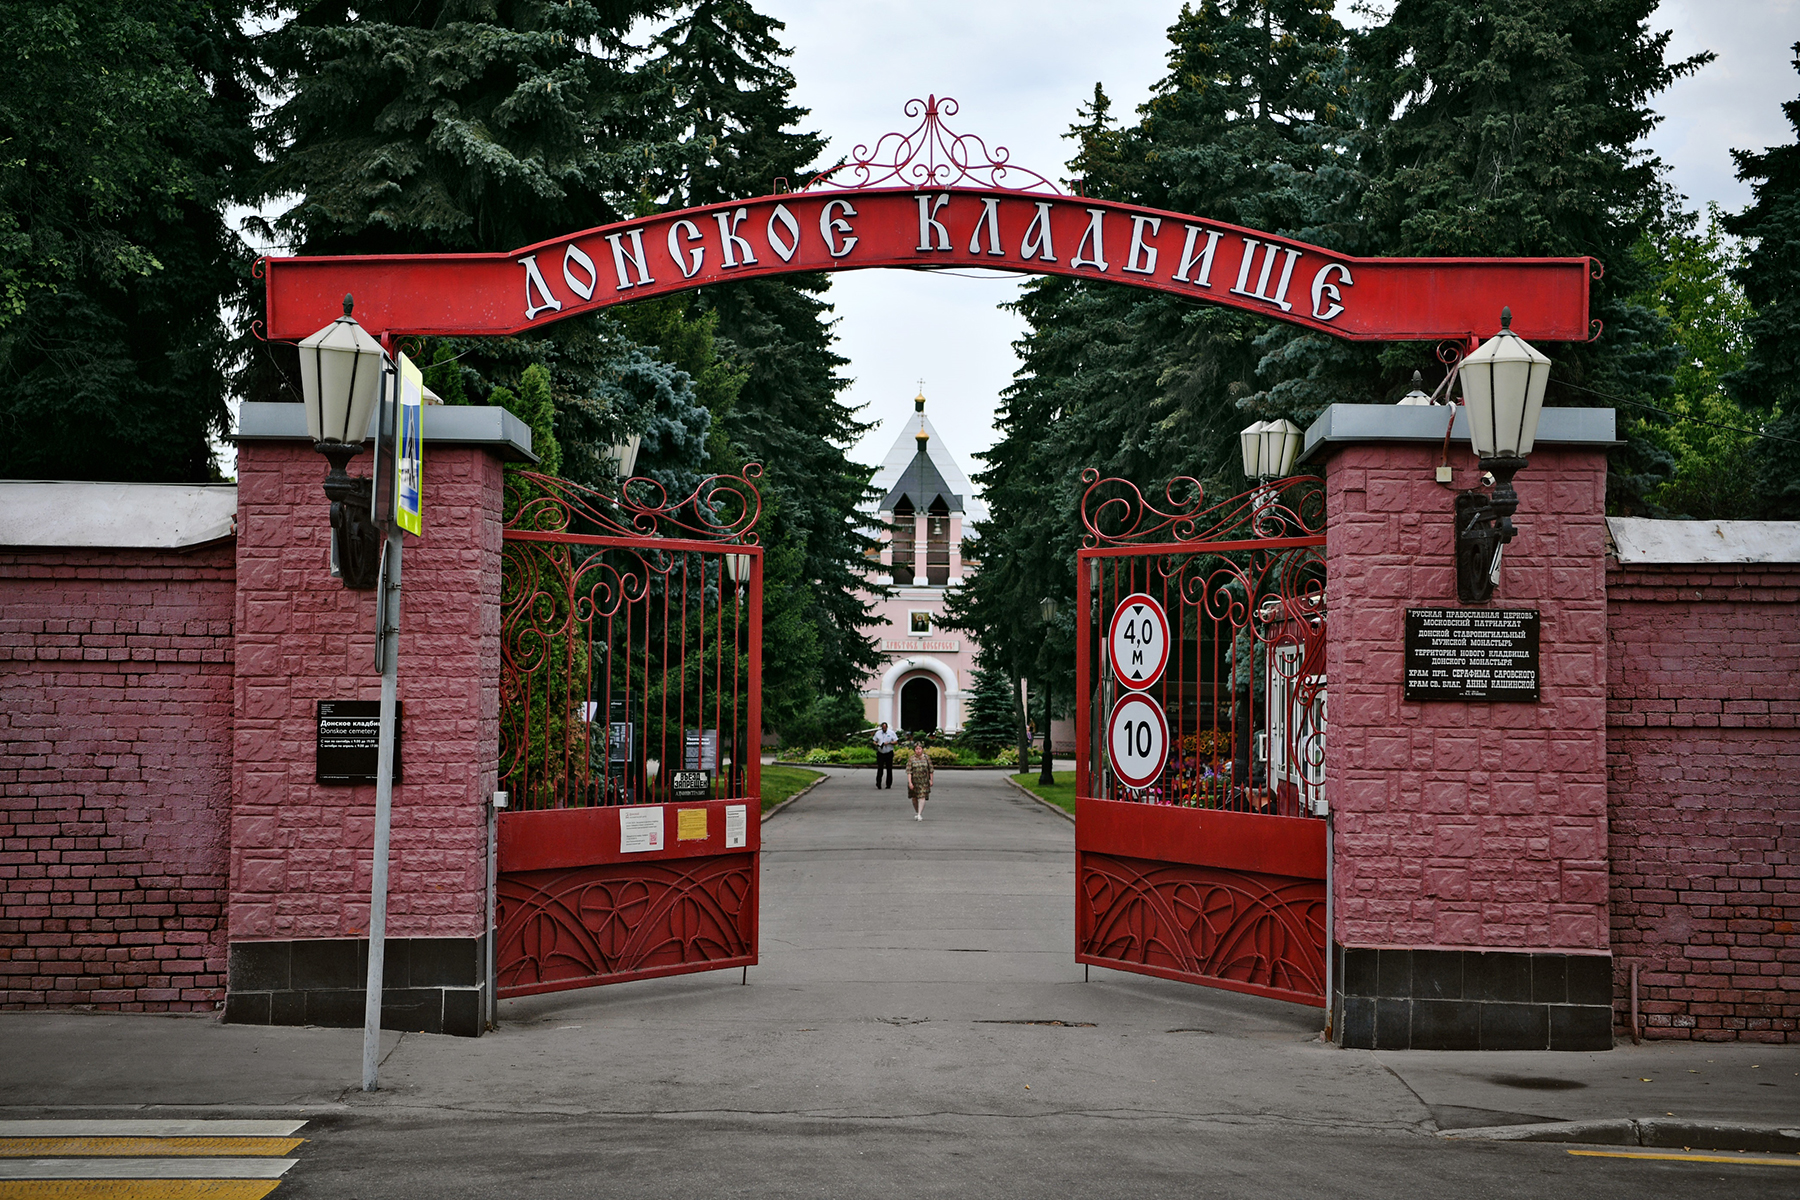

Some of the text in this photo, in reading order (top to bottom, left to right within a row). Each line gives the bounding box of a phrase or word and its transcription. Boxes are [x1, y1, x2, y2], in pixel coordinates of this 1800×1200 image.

[1446, 611, 1500, 619] ПРАВОСЛАВНАЯ
[1503, 612, 1533, 620] ЦЕРКОВЬ
[1423, 619, 1470, 627] МОСКОВСКИЙ
[1124, 619, 1153, 648] 4,0
[1418, 629, 1526, 639] ДОНСКОЙ СТАВРОПИГИАЛЬНЫЙ
[1432, 638, 1513, 647] МУЖСКОЙ МОНАСТЫРЬ
[1414, 649, 1456, 657] ТЕРРИТОРИЯ
[1489, 650, 1530, 658] КЛАДБИЩА
[1431, 658, 1512, 666] ДОНСКОГО МОНАСТЫРЯ
[1408, 669, 1428, 677] ХРАМ
[1452, 669, 1490, 678] СЕРАФИМА
[1494, 670, 1535, 679] САРОВСКОГО
[1466, 680, 1487, 688] АННЫ
[1491, 679, 1535, 689] КАШИНСКОЙ
[349, 728, 377, 736] cemetery
[1124, 720, 1152, 758] 10
[680, 772, 701, 781] ВЪЕЗД
[674, 780, 708, 788] ЗАПРЕЩЕН
